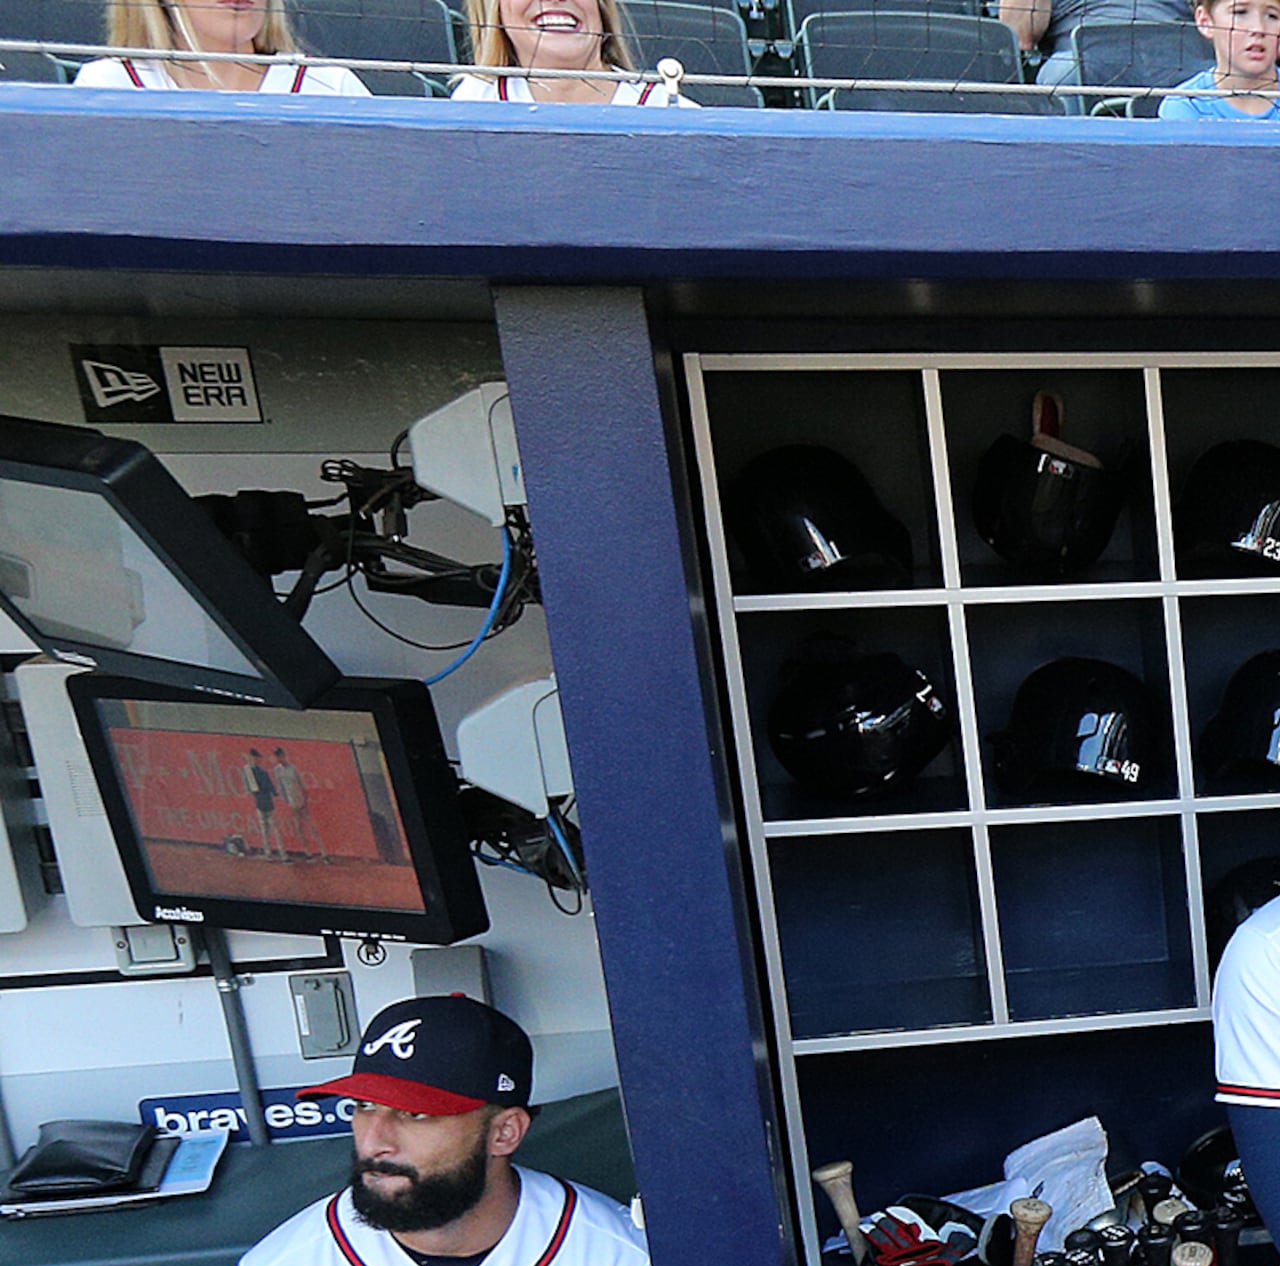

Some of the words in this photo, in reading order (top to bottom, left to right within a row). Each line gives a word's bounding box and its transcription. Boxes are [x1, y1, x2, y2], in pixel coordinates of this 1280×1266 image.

[177, 362, 242, 383] NEW
[183, 385, 248, 406] ERA
[1121, 760, 1140, 782] 49
[363, 1019, 422, 1059] A
